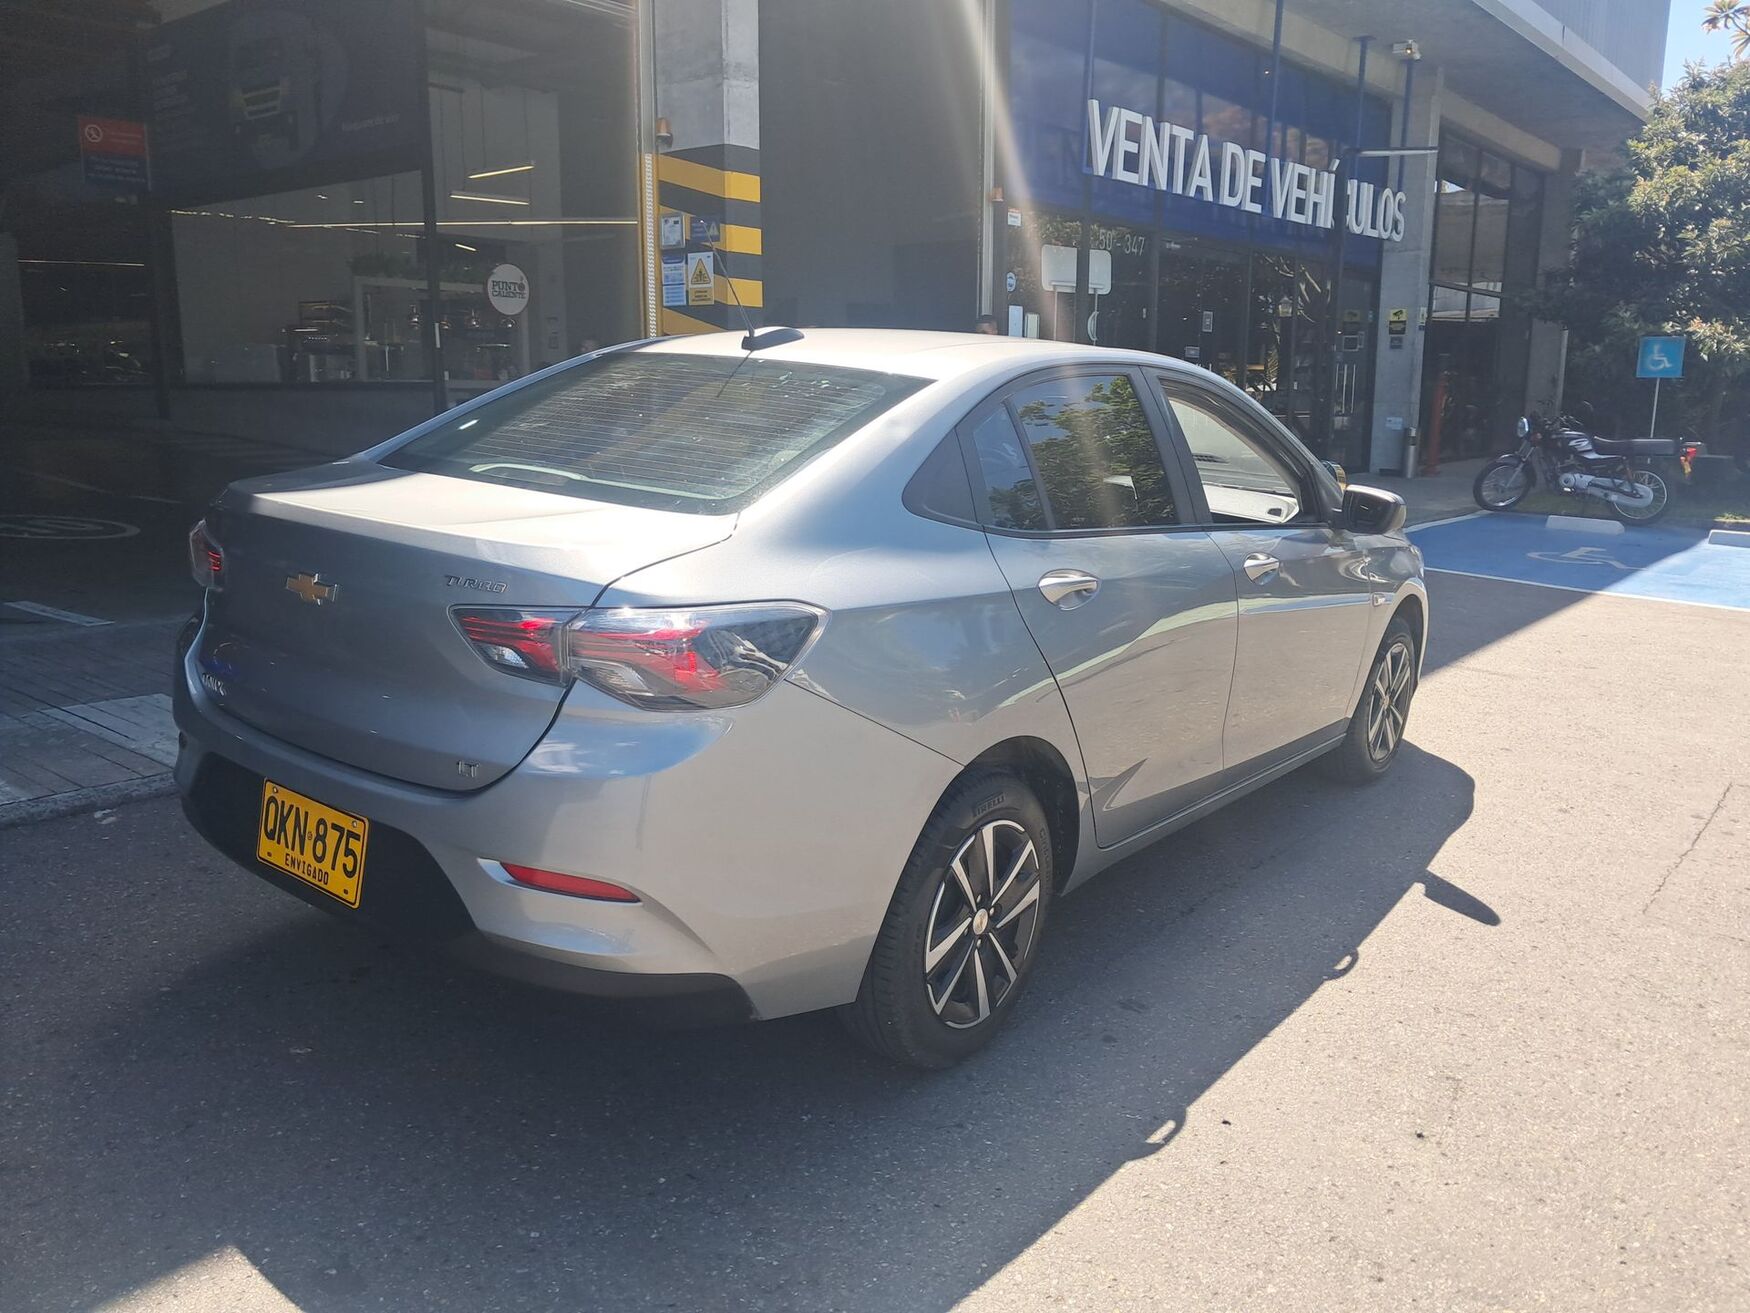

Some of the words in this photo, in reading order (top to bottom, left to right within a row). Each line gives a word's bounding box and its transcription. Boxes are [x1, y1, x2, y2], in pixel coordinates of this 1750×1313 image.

[1087, 99, 1213, 202] VENTA
[1219, 141, 1267, 214] DE
[491, 279, 526, 292] PUNTO
[444, 574, 509, 593] TURBO
[457, 760, 481, 778] LT
[972, 792, 1006, 818] PIRELLI
[284, 853, 329, 886] ENVIGADO
